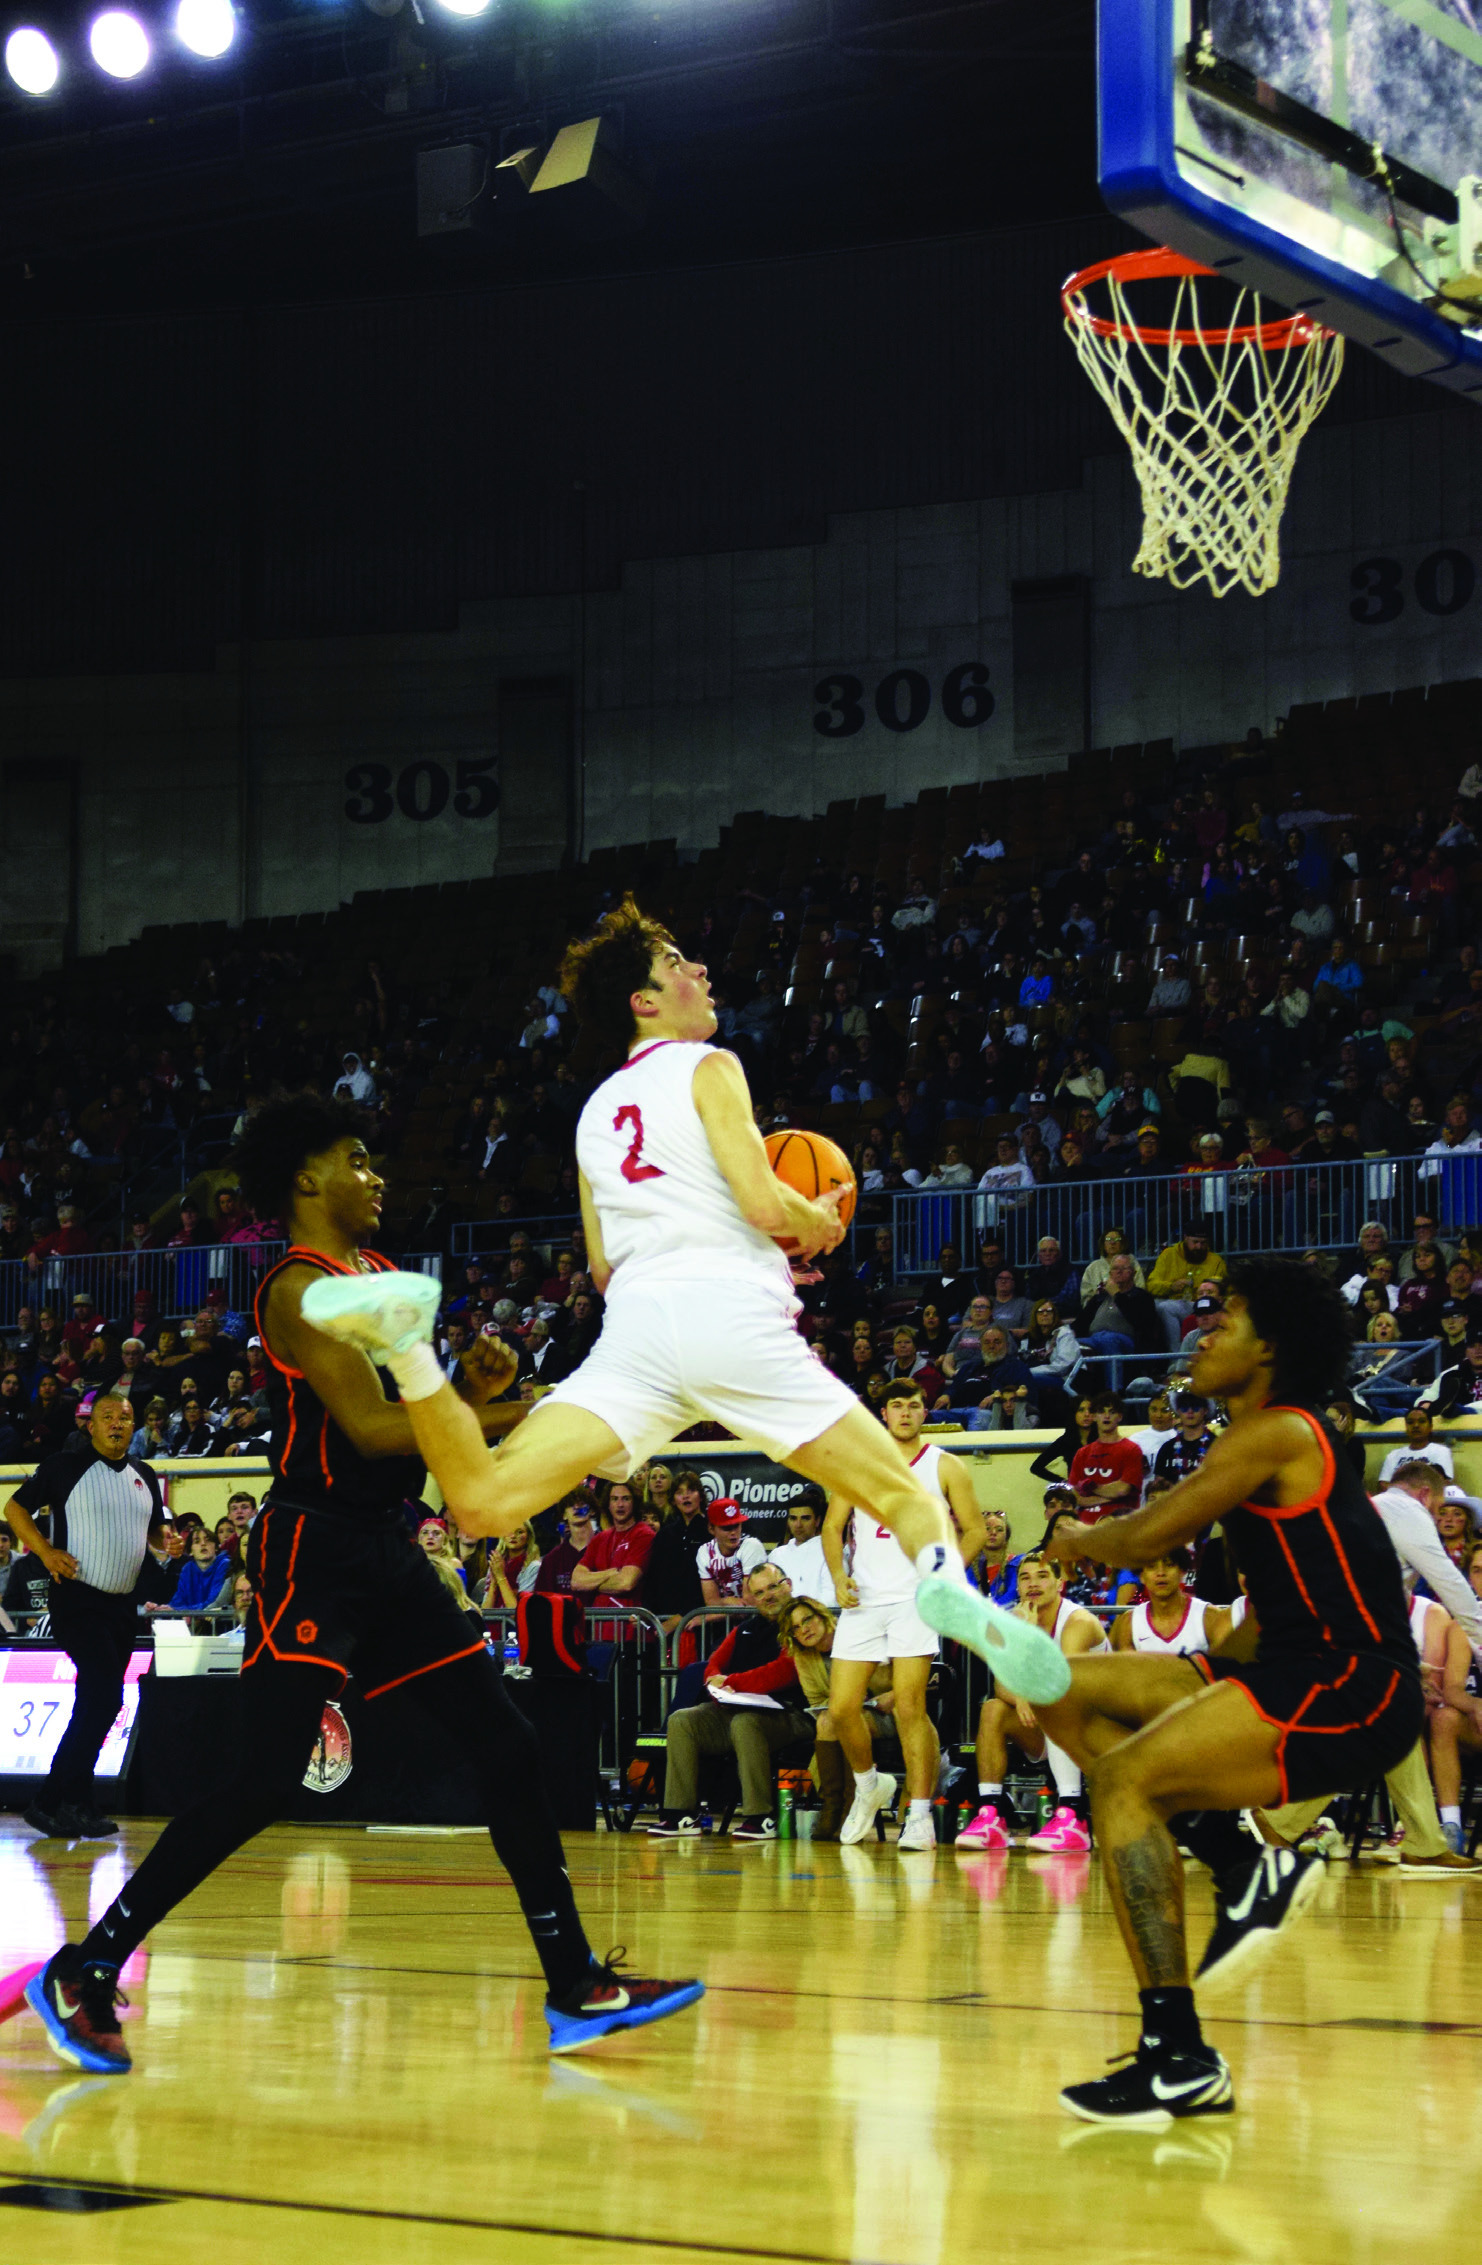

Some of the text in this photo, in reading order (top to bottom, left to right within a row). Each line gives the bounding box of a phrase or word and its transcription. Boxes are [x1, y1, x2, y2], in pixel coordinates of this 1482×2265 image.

[812, 661, 996, 738] 306
[344, 755, 502, 824] 305
[612, 1103, 667, 1185] 2
[728, 1477, 809, 1503] Pionee
[13, 1701, 61, 1738] 37
